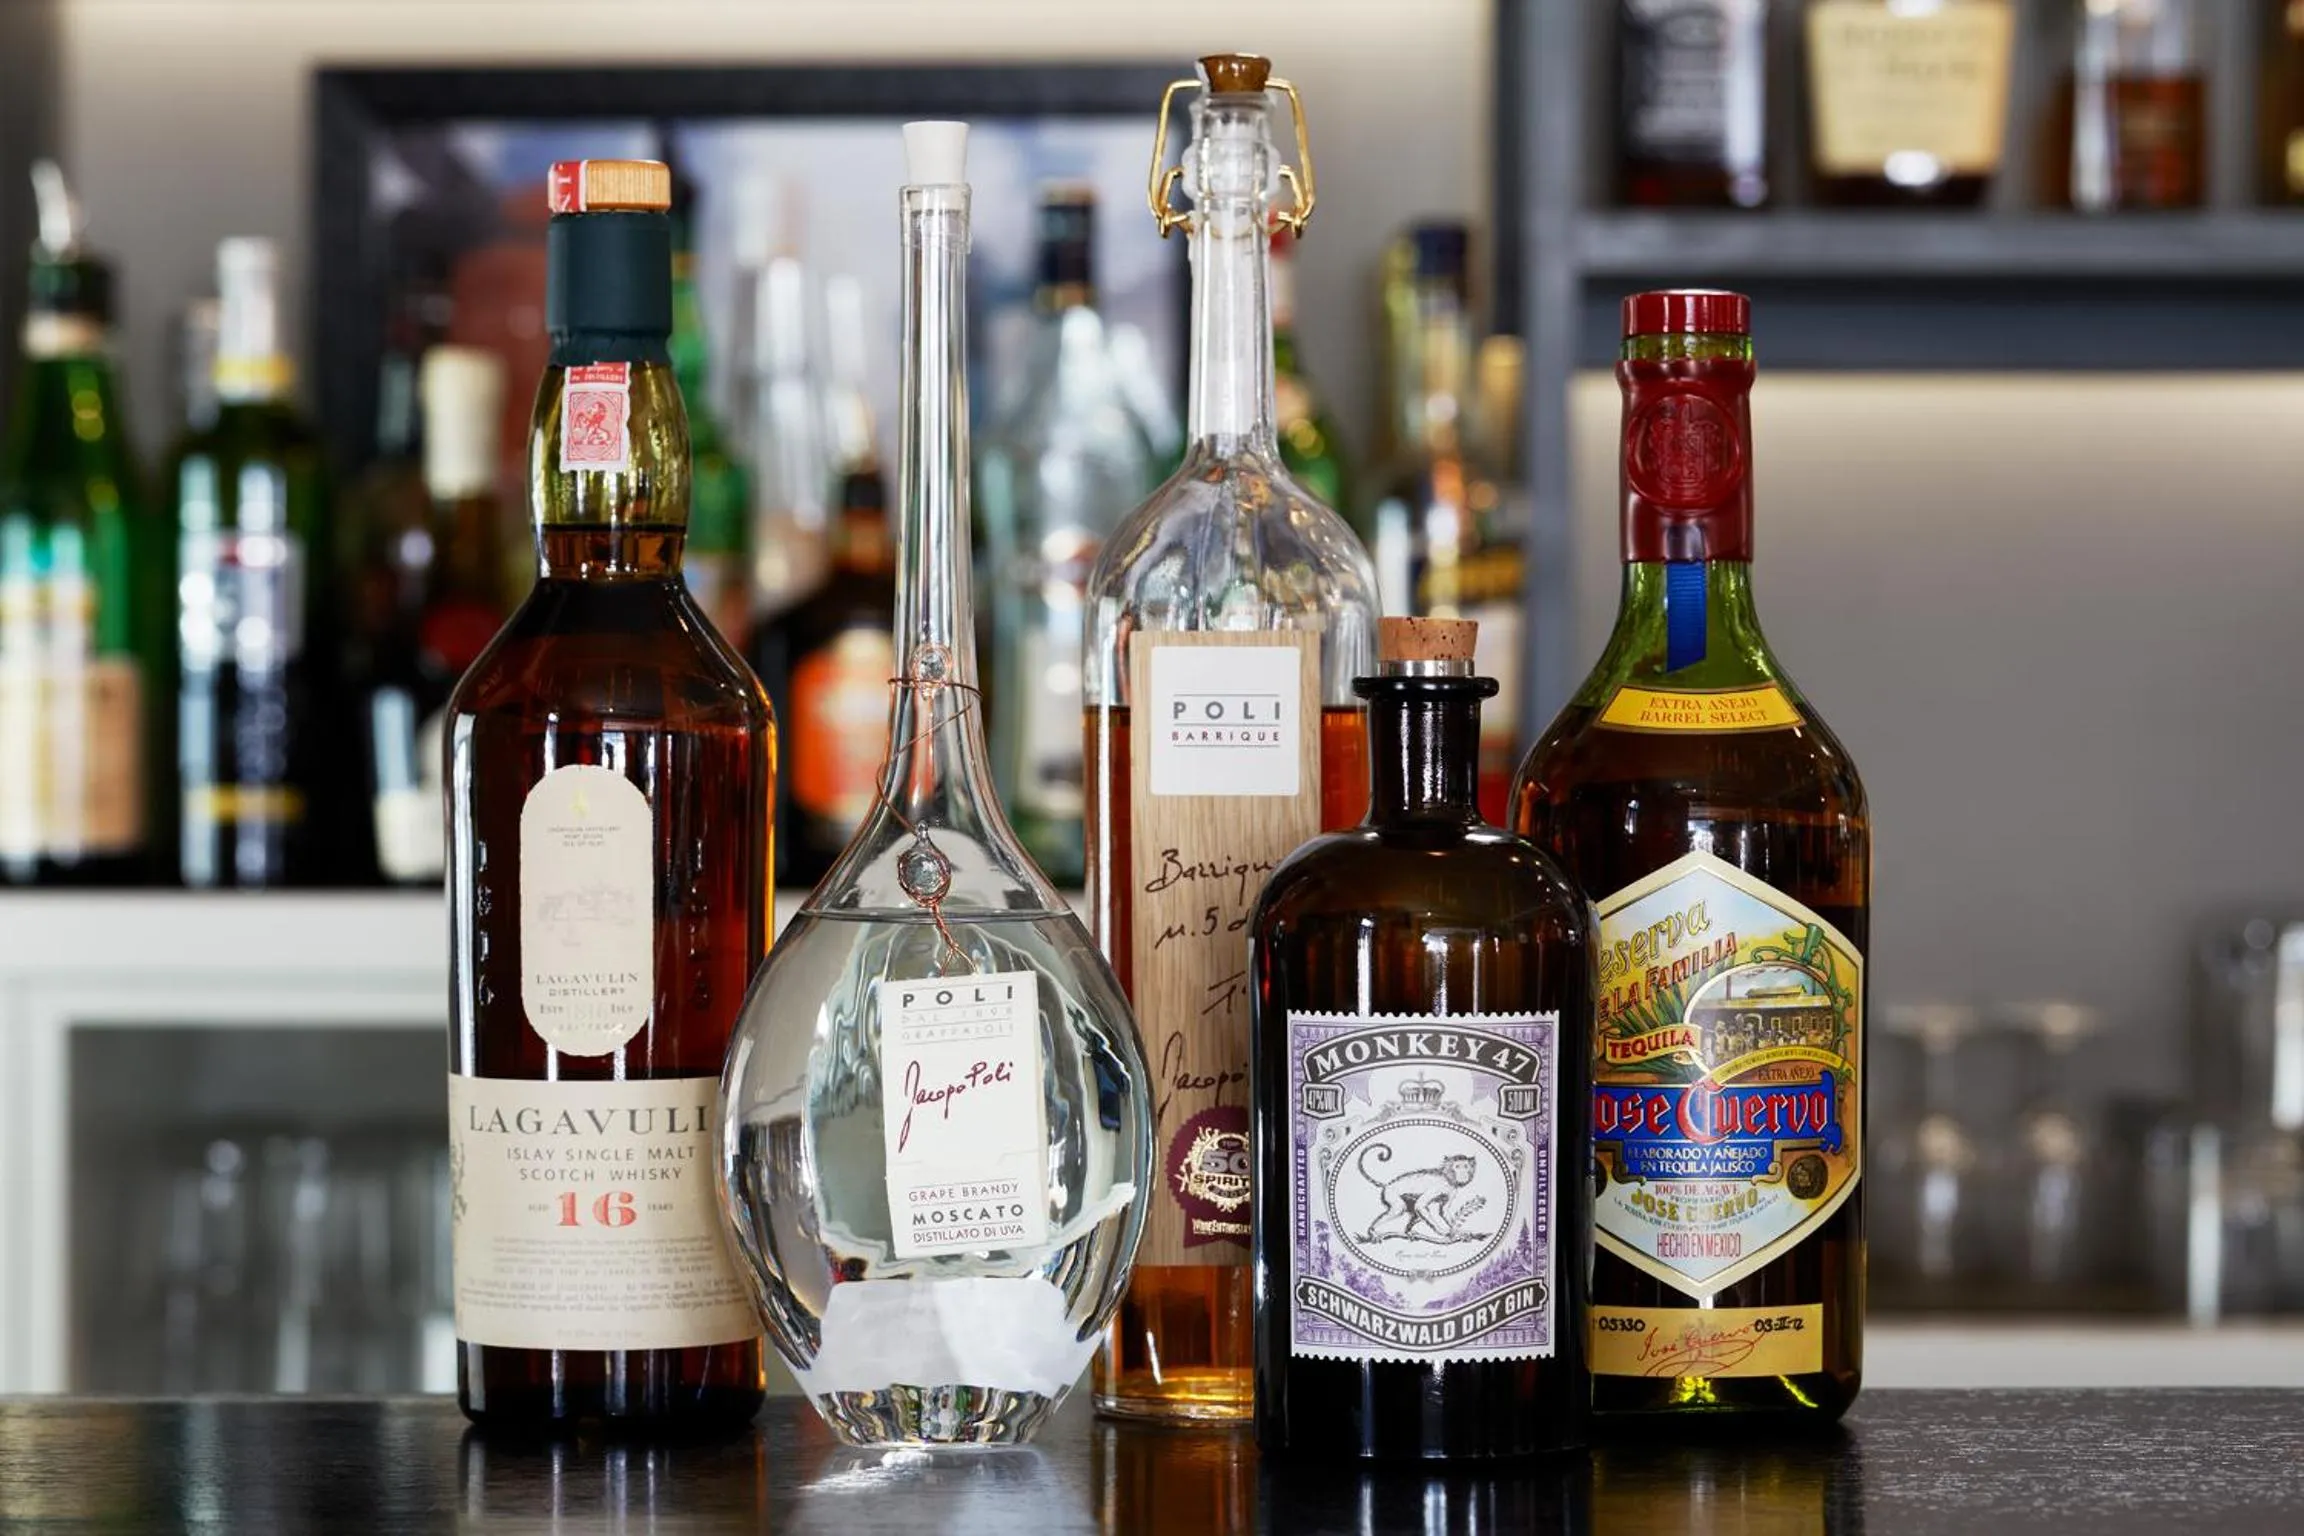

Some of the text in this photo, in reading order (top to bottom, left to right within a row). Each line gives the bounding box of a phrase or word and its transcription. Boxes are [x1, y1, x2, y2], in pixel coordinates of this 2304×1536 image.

[1173, 701, 1280, 720] POLI
[1640, 711, 1768, 724] BARREL SELECT
[1650, 697, 1703, 711] EXTRA
[1172, 731, 1279, 741] BARRIQUE
[1145, 848, 1275, 906] Barriqu
[1600, 898, 1711, 984] eserva
[1613, 981, 1640, 1015] LA
[1645, 932, 1738, 1000] FAMILIA
[903, 985, 1012, 1008] POLI
[1313, 1032, 1531, 1077] MONKEY 47
[1608, 1030, 1695, 1059] TEQUILA
[964, 1060, 1013, 1088] Poli
[470, 1105, 708, 1135] LAGAVULI
[1595, 1079, 1828, 1146] ose Cuervo
[507, 1146, 697, 1161] ISLAY SINGLE MALT
[1628, 1145, 1768, 1161] ELABORADO Y AÑEJADO
[520, 1167, 683, 1181] SCOTCH WHISKY
[1641, 1161, 1756, 1176] EN TEQUILA JALISCO
[909, 1182, 1019, 1201] GRAPE BRANDY
[1297, 1148, 1306, 1236] HANDCRAFTED
[1538, 1149, 1547, 1231] UNFILTERED
[555, 1191, 637, 1227] 16
[912, 1204, 1024, 1225] MOSCATO
[1631, 1188, 1679, 1221] JOSE
[913, 1225, 1025, 1243] DISTILLATO DI UVA
[1657, 1232, 1741, 1258] HECHO EN MEXICO
[1308, 1286, 1534, 1344] SCHWARZWALD DRY GIN
